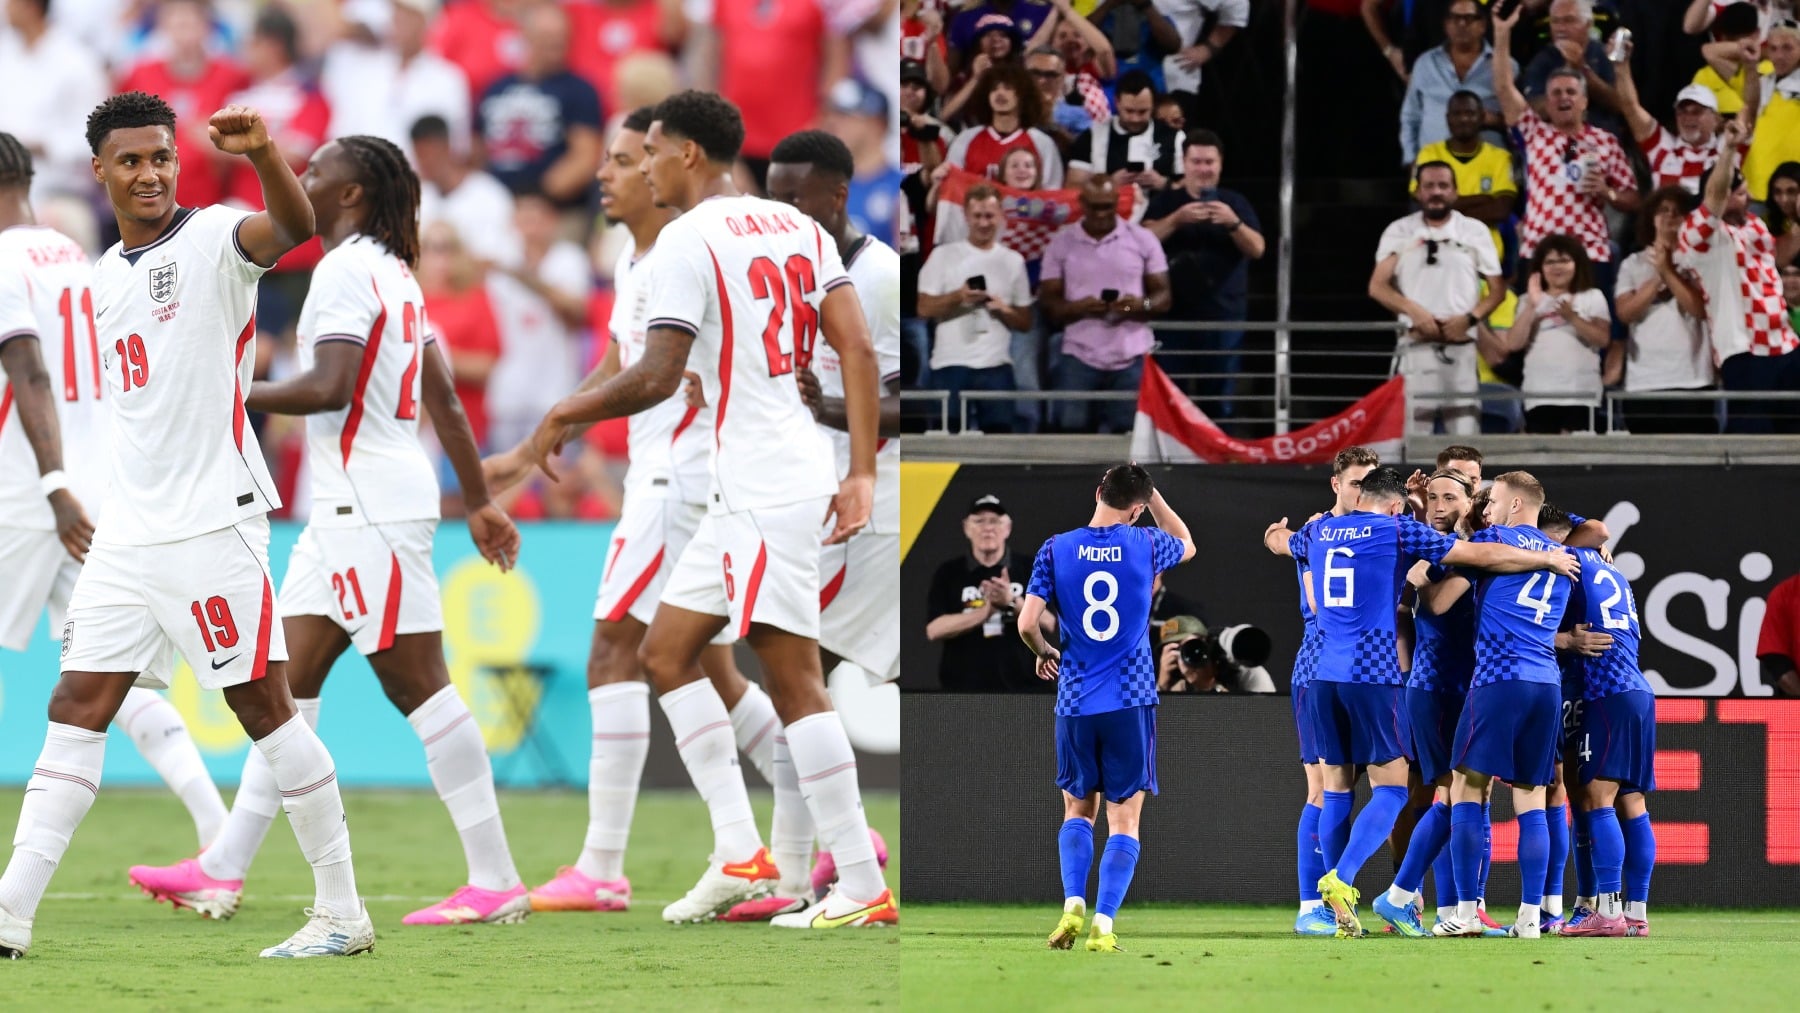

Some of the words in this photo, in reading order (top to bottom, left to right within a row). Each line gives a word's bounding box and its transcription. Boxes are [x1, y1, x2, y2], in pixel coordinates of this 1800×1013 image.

[59, 287, 102, 402] 11
[747, 253, 819, 378] 26
[115, 333, 149, 392] 19
[1078, 545, 1122, 562] MORO
[1323, 546, 1355, 608] 6
[332, 566, 368, 621] 21
[1082, 570, 1120, 642] 8
[1516, 572, 1557, 625] 4
[191, 595, 239, 652] 19
